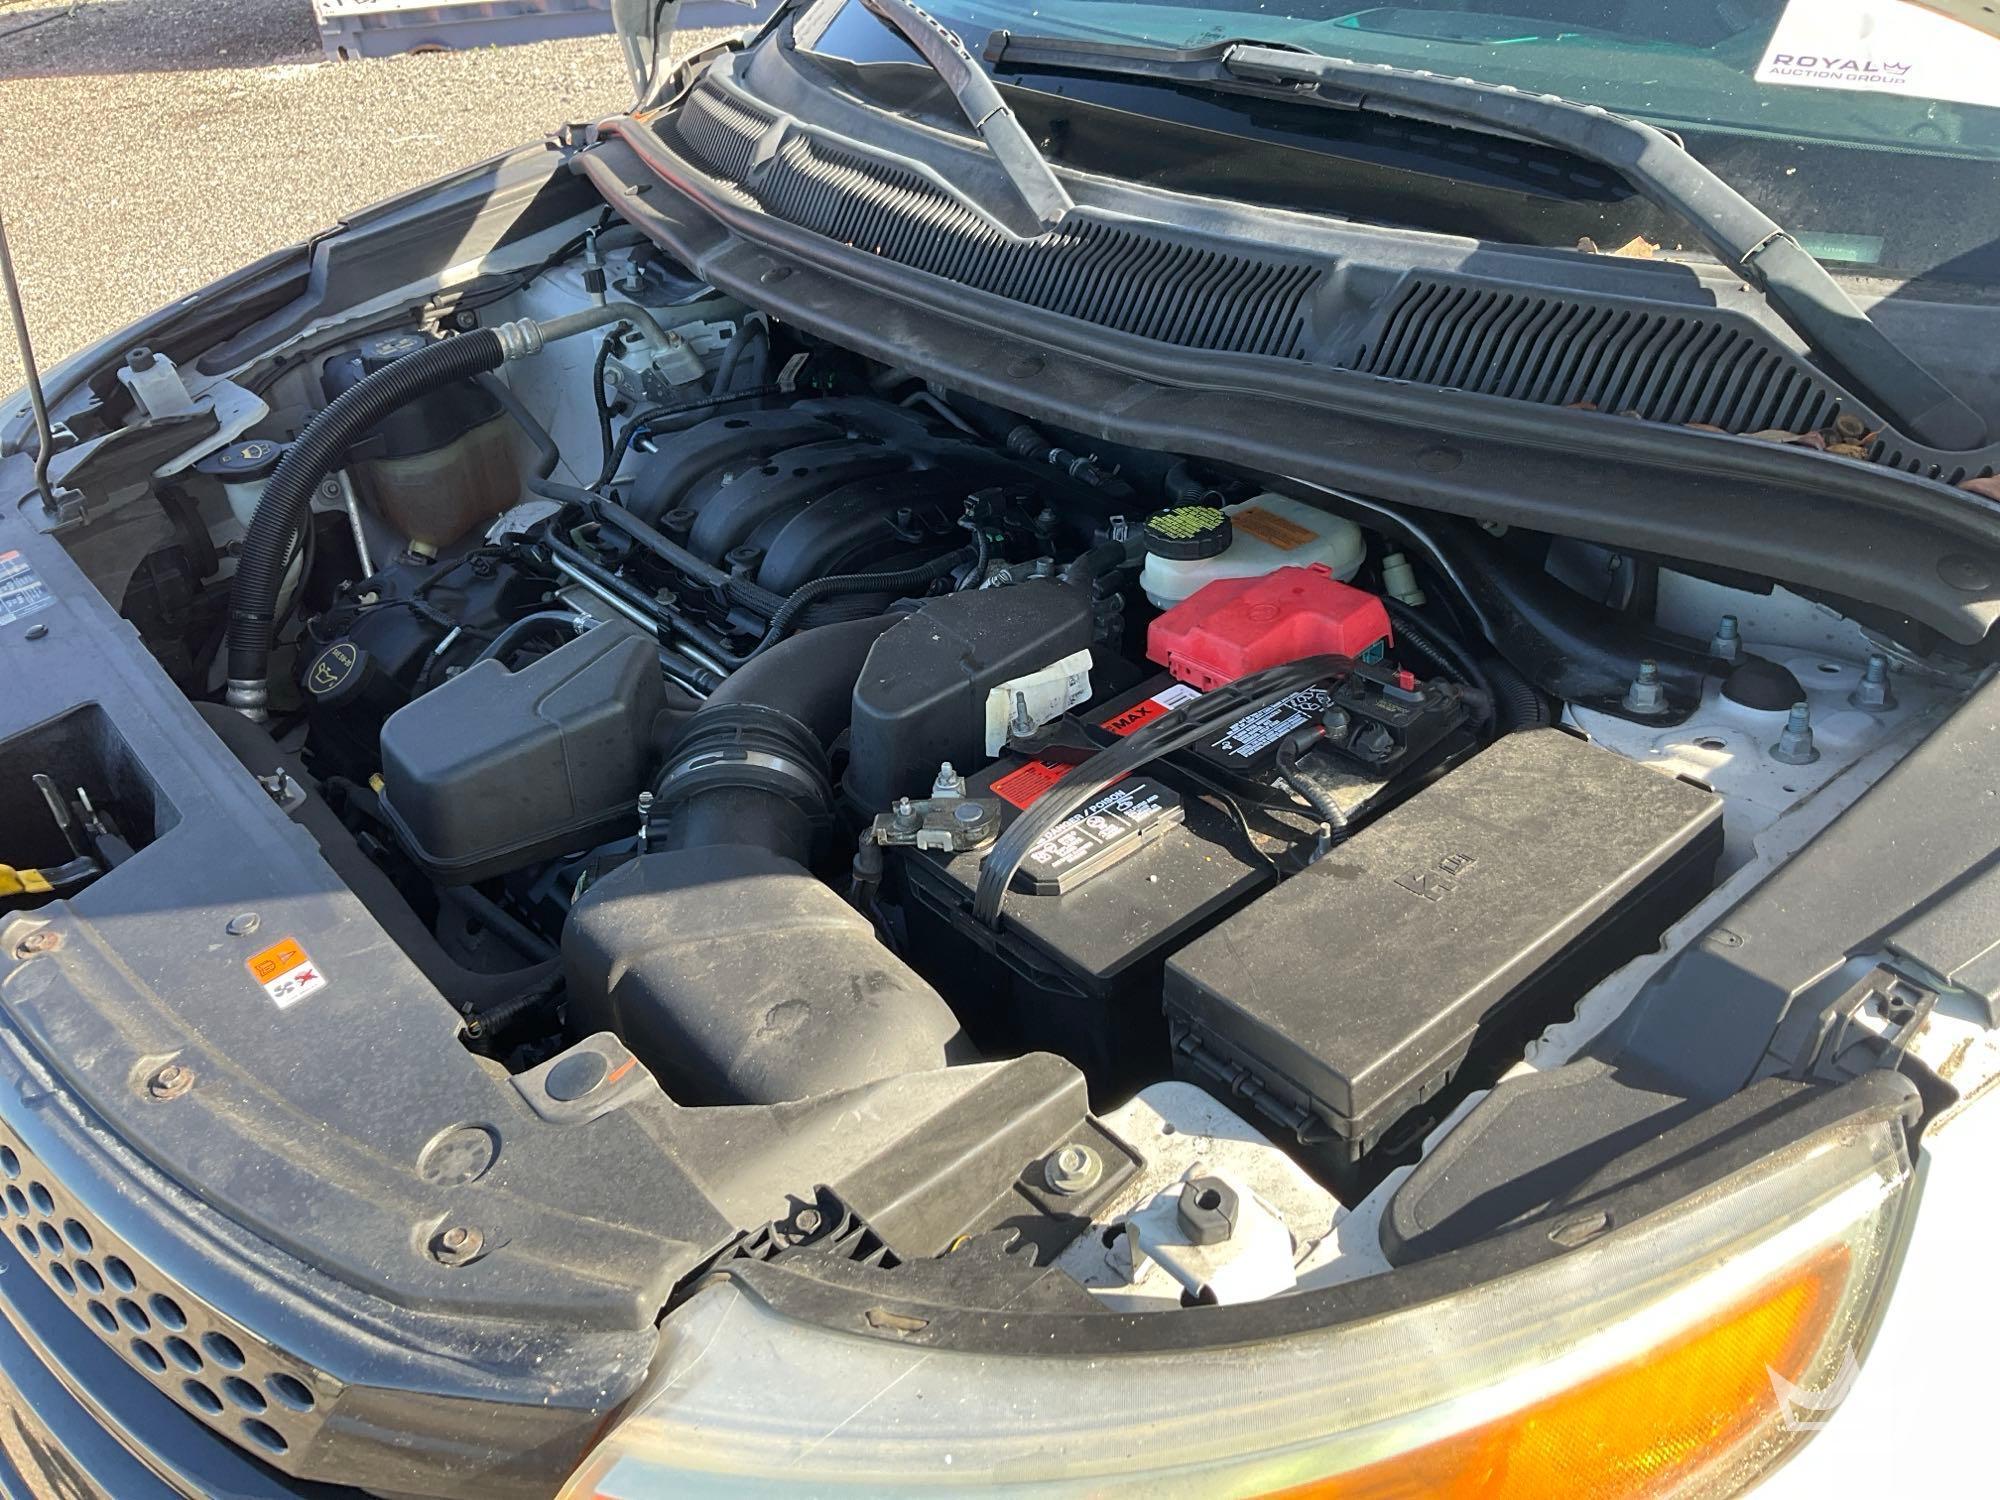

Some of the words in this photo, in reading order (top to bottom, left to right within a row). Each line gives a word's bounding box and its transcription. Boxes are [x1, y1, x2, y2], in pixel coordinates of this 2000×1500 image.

[1773, 54, 1879, 72] ROYAL
[1770, 67, 1842, 79] AUCTION
[1846, 73, 1906, 84] GROUP
[1111, 707, 1152, 729] MAX
[1046, 813, 1085, 838] DANGER
[1089, 790, 1126, 813] POISON
